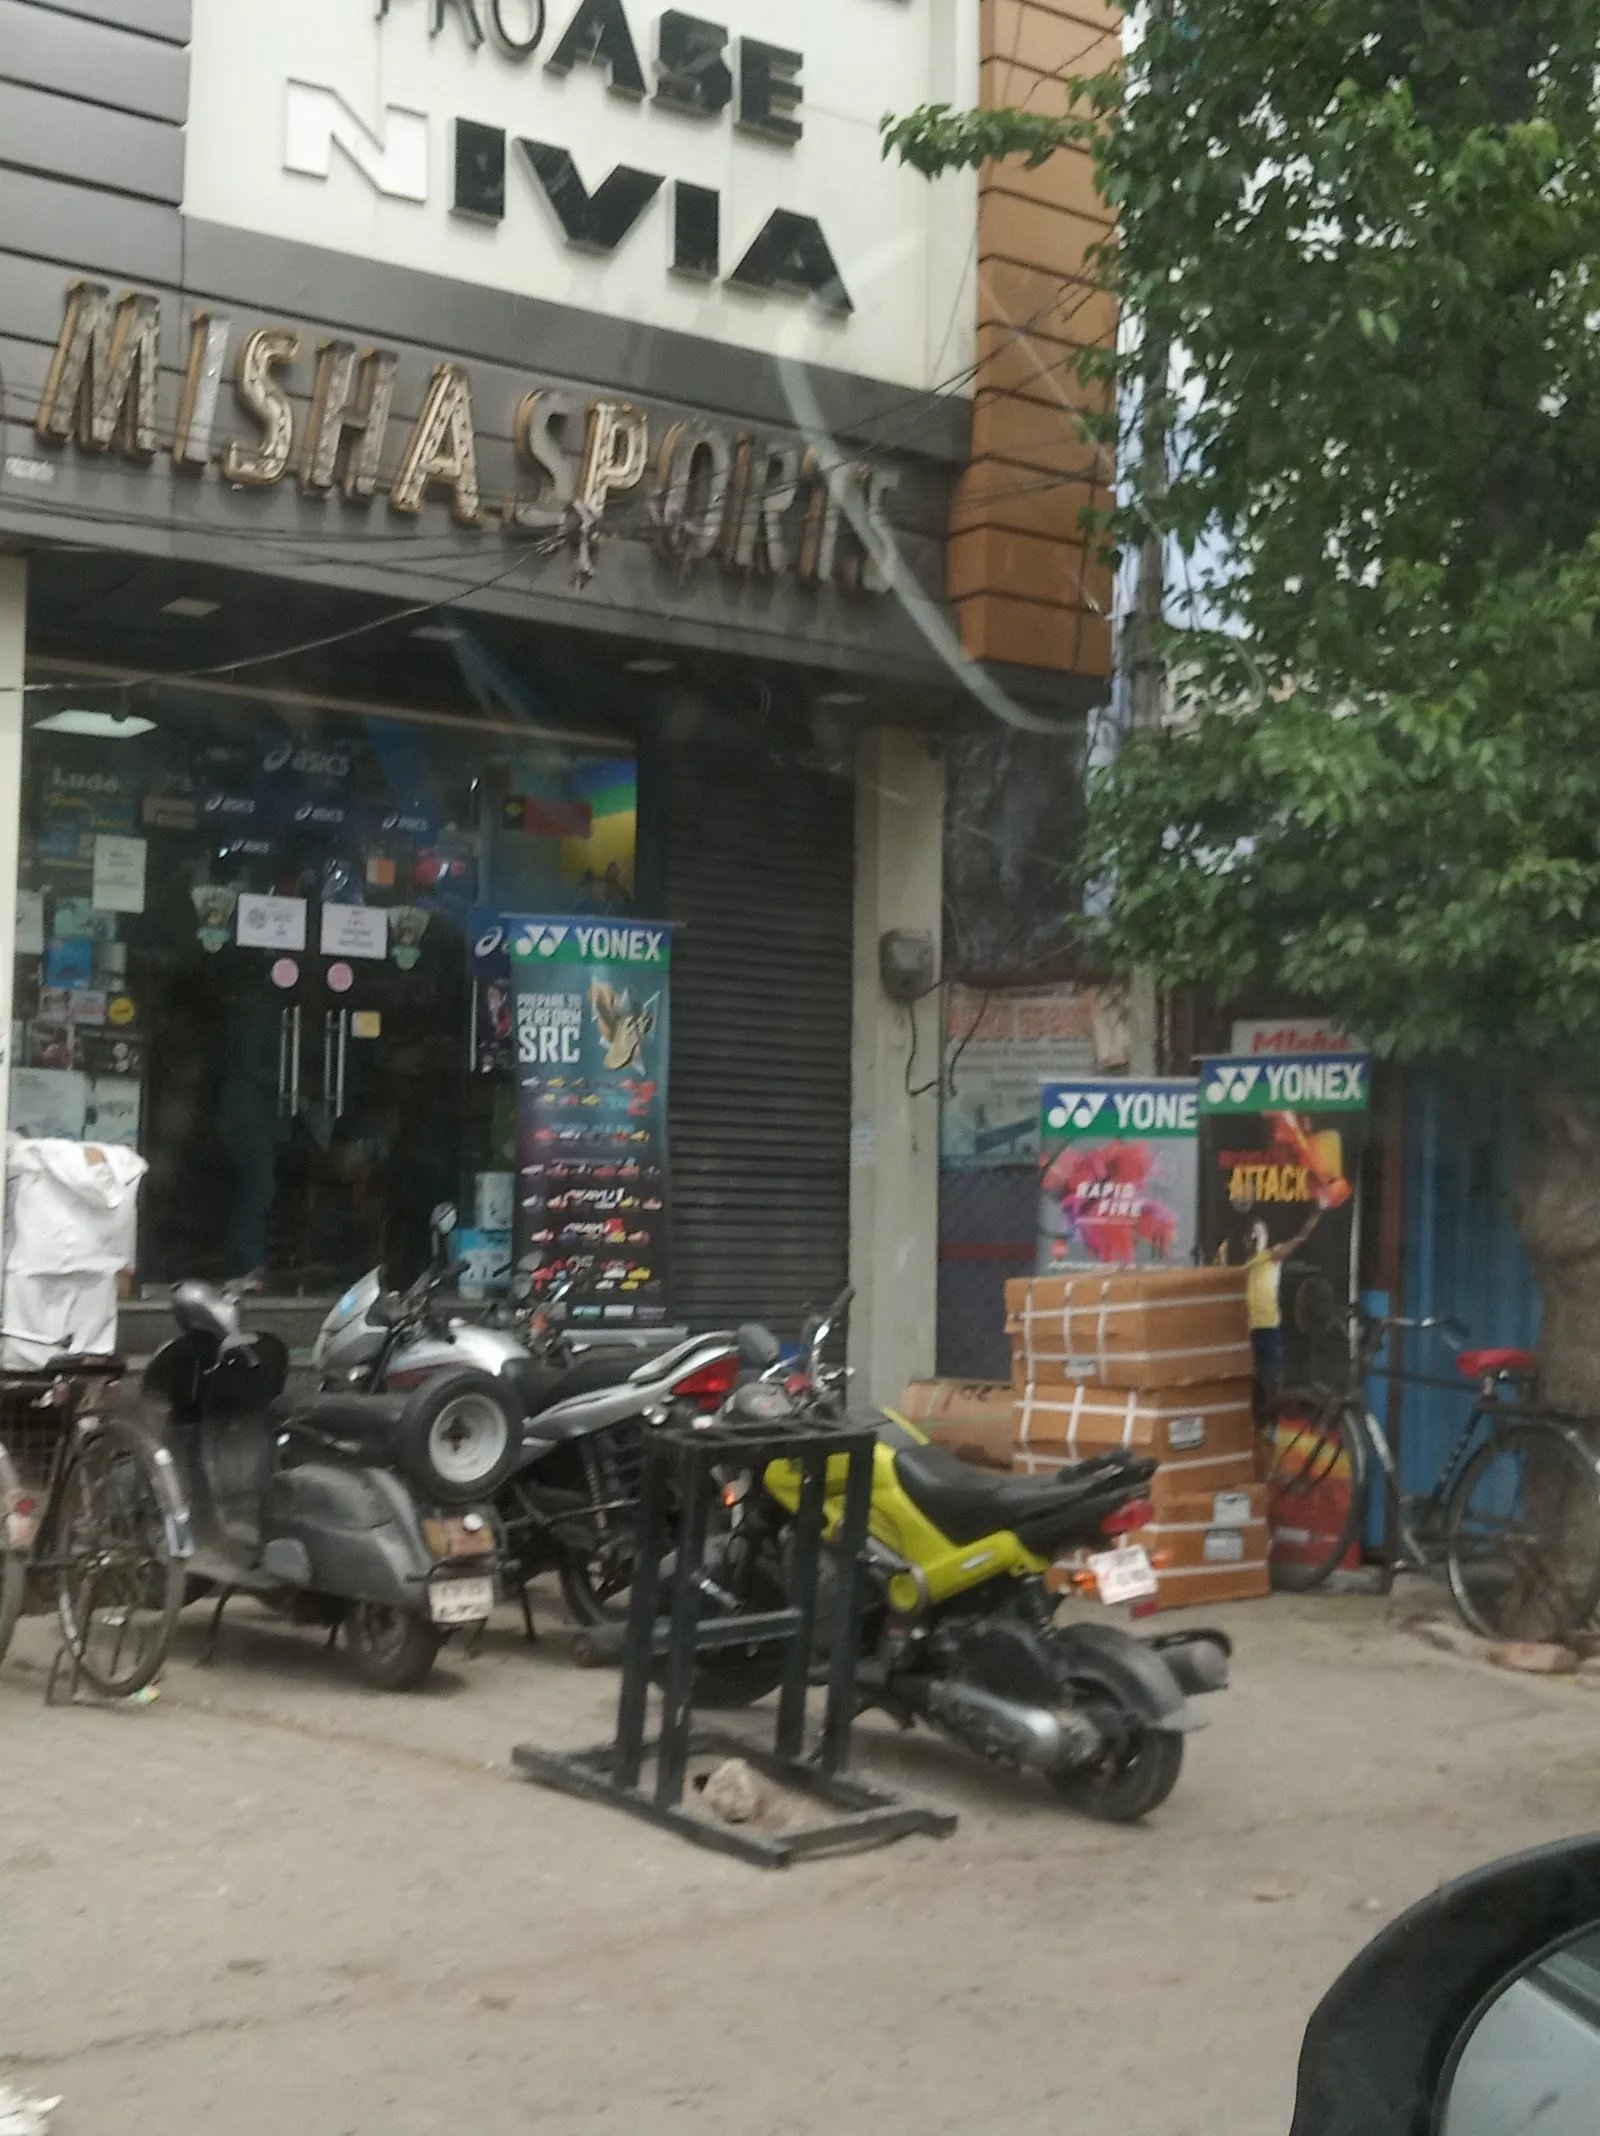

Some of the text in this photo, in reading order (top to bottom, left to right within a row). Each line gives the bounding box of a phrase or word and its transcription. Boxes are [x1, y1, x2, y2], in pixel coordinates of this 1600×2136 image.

[373, 0, 804, 146] OASE
[282, 77, 855, 315] NIVIA
[36, 278, 485, 527] MISHA
[574, 925, 664, 962] YONEX
[518, 1025, 581, 1064] SRC
[1265, 1062, 1364, 1101] YONEX
[1113, 1092, 1198, 1129] YONE
[1076, 1180, 1136, 1198] RAPID
[1229, 1164, 1310, 1201] ATTACK
[1098, 1199, 1143, 1216] FIRE
